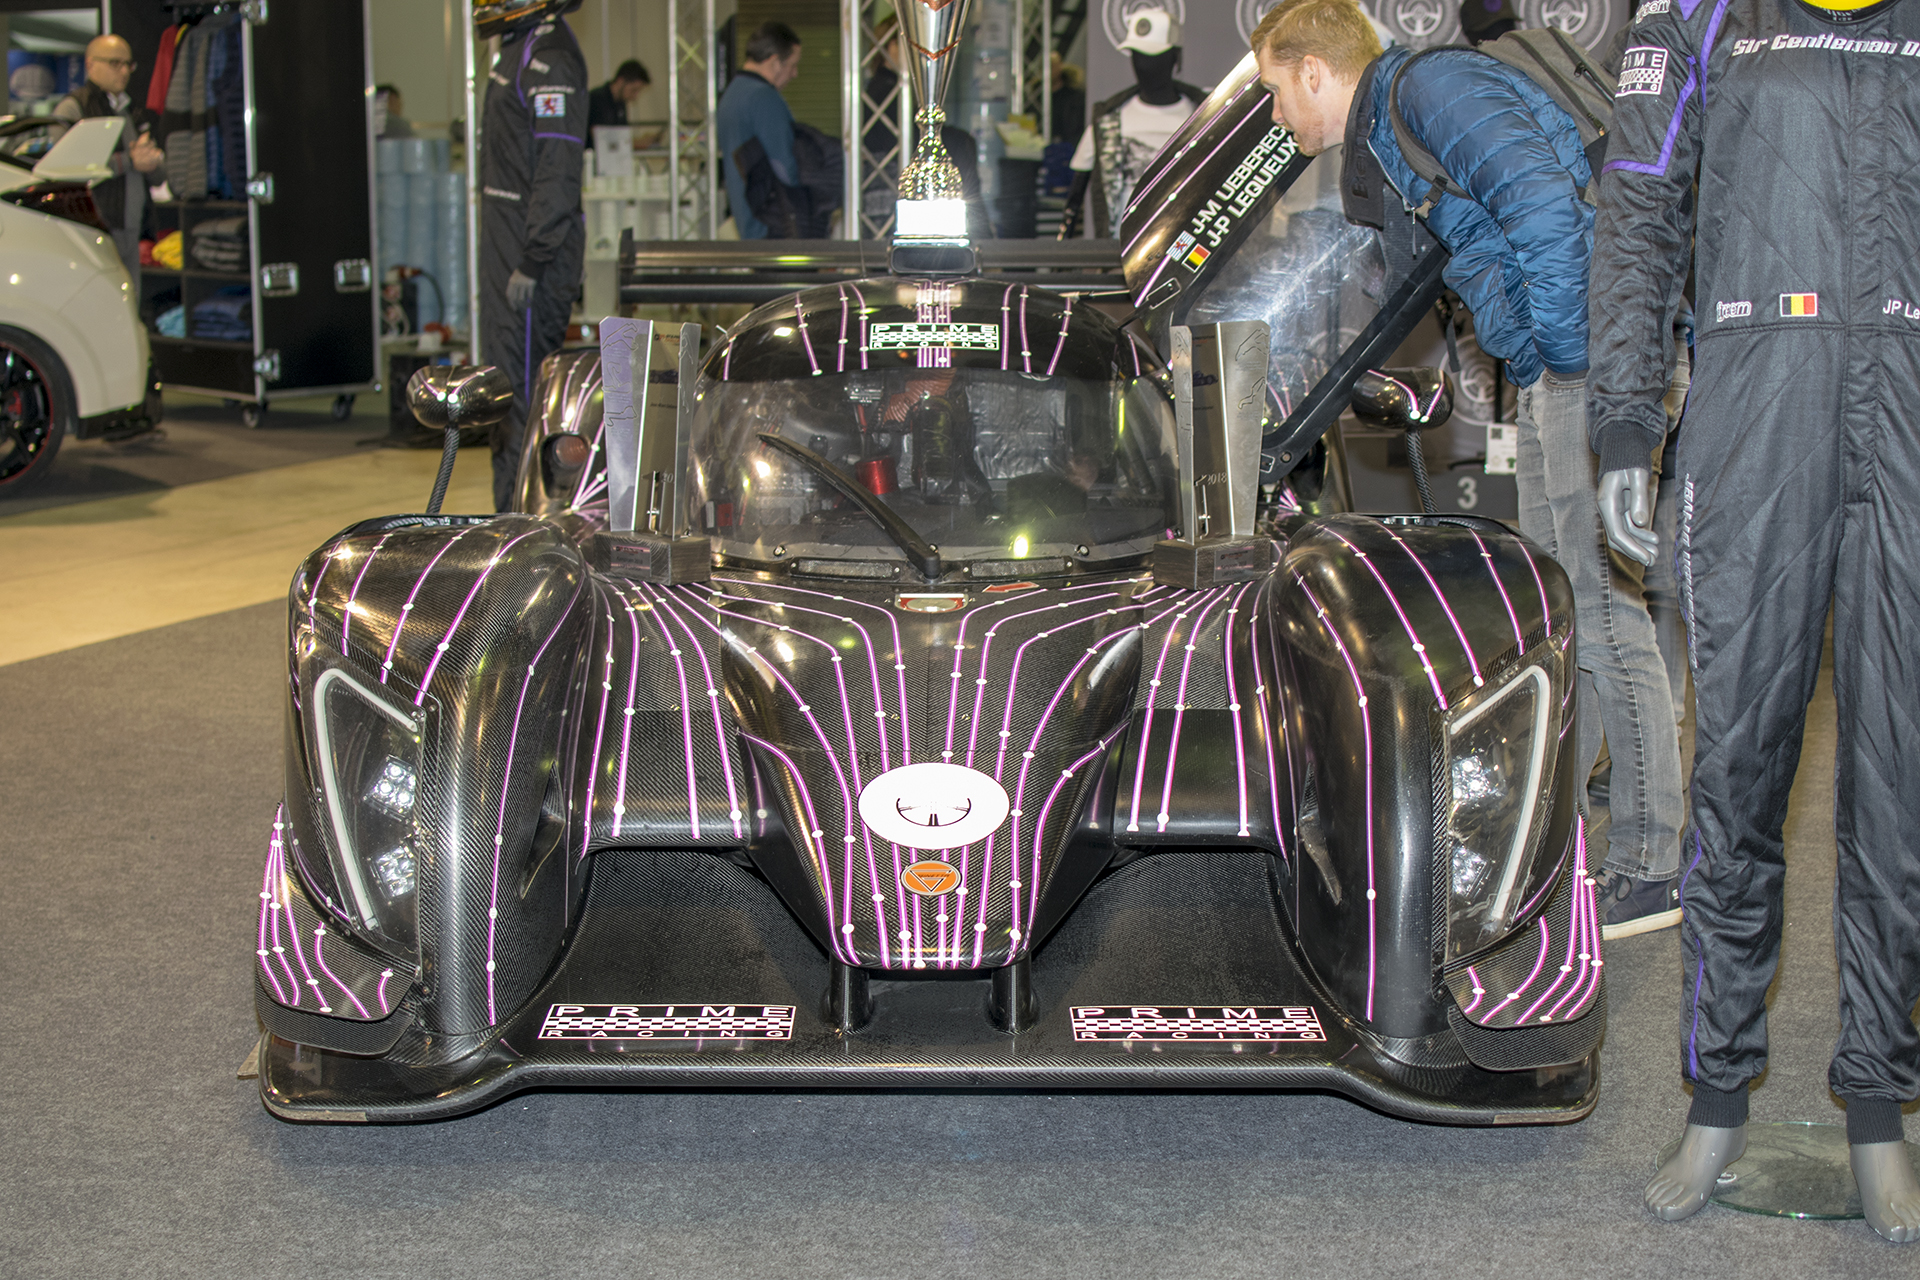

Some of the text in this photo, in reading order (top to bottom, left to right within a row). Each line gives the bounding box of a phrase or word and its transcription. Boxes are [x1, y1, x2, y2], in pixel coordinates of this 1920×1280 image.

[1770, 32, 1898, 55] Gentleman
[1206, 135, 1299, 248] J-P LEQUEUX
[1191, 199, 1222, 235] J-M
[1882, 299, 1902, 314] JP
[875, 324, 995, 333] PRIME
[1457, 476, 1478, 510] 3
[555, 1006, 789, 1018] PRIME
[1077, 1007, 1311, 1019] PRIME
[1081, 1031, 1318, 1039] RACING
